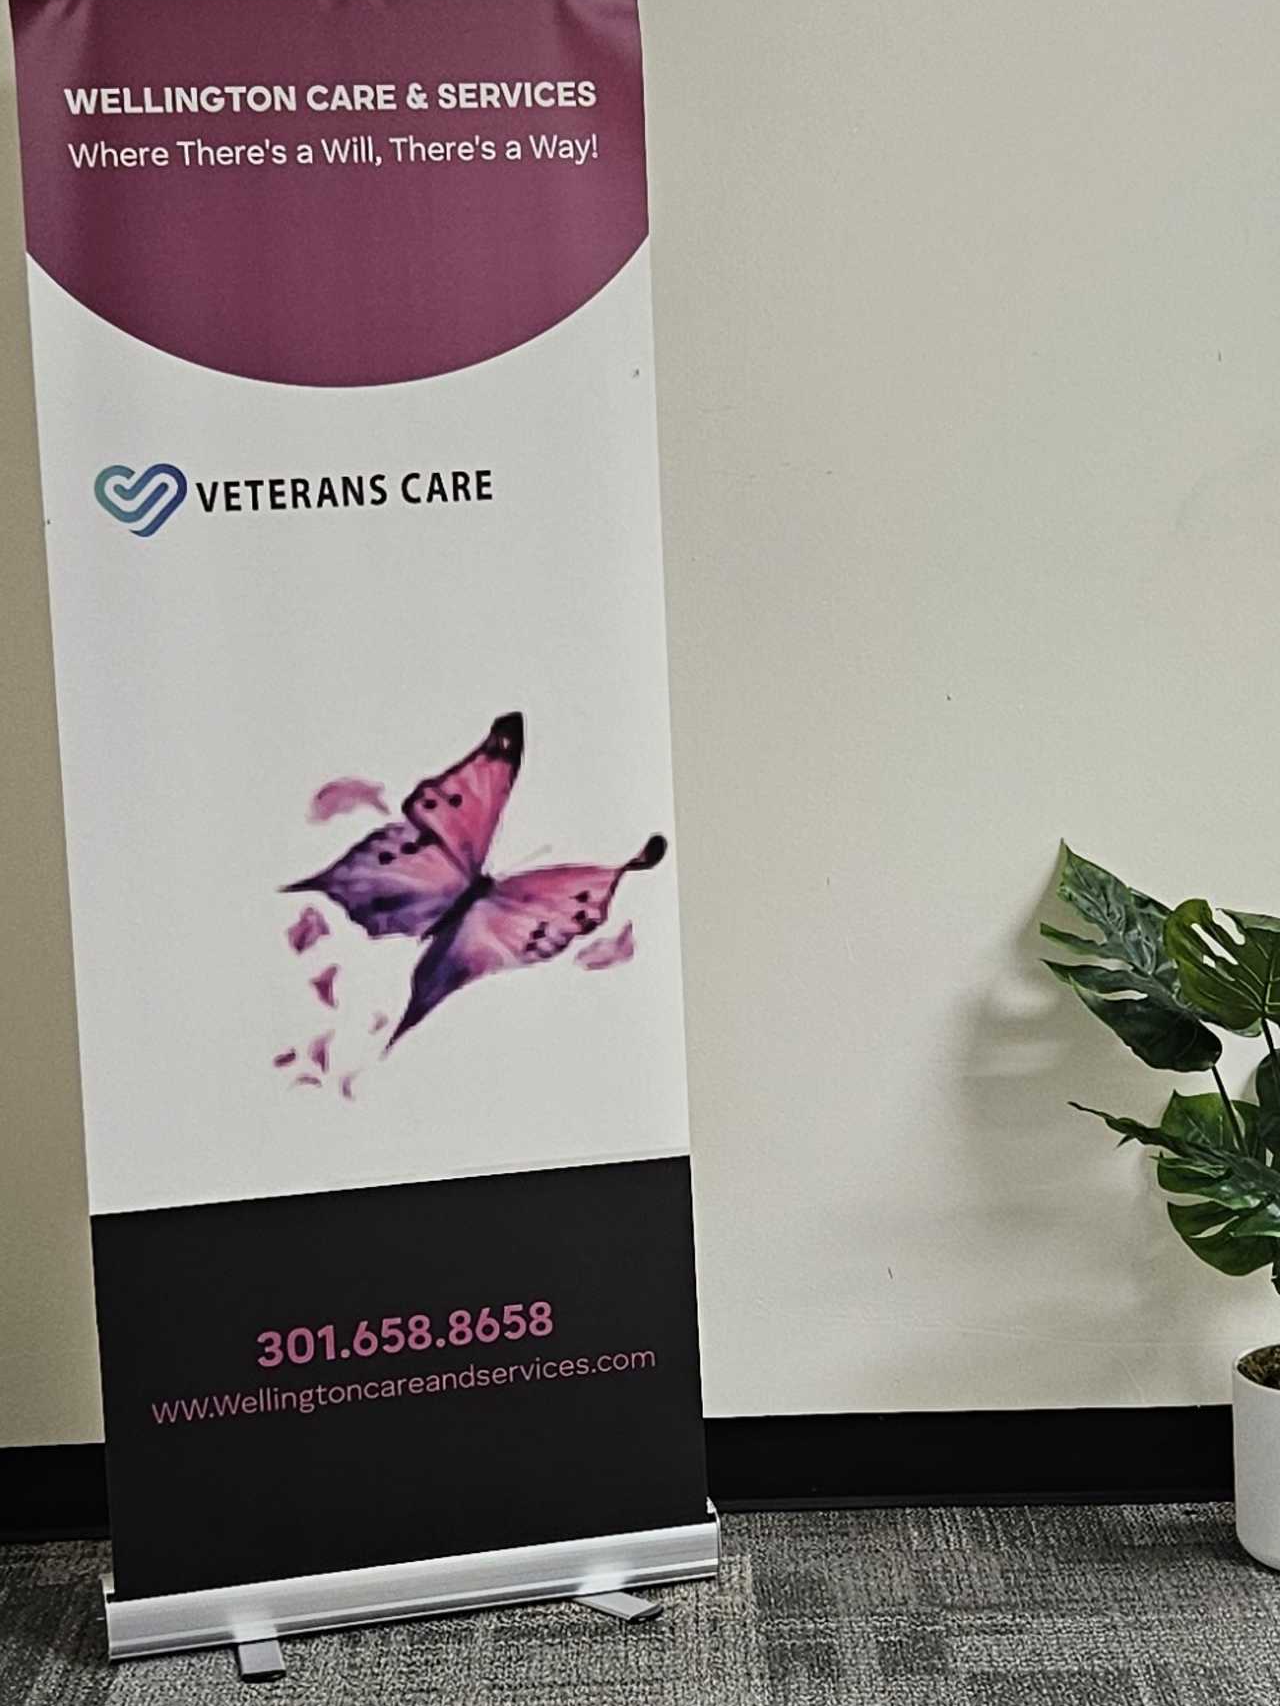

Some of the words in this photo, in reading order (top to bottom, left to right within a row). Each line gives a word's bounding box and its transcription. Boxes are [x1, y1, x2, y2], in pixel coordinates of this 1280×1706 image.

[63, 84, 297, 115] WELLINGTON
[306, 83, 397, 112] CARE
[406, 82, 429, 110] &
[438, 80, 597, 109] SERVICES
[67, 140, 169, 169] Where
[176, 138, 288, 166] There's
[296, 144, 314, 165] a
[320, 135, 382, 167] Will,
[388, 135, 497, 163] There's
[505, 139, 522, 160] a
[528, 133, 599, 166] Way!
[195, 473, 388, 513] VETERANS
[401, 469, 493, 504] CARE
[256, 1301, 554, 1368] 301.658.8658
[151, 1346, 656, 1425] WW.Wellingtoncareandservices.com
